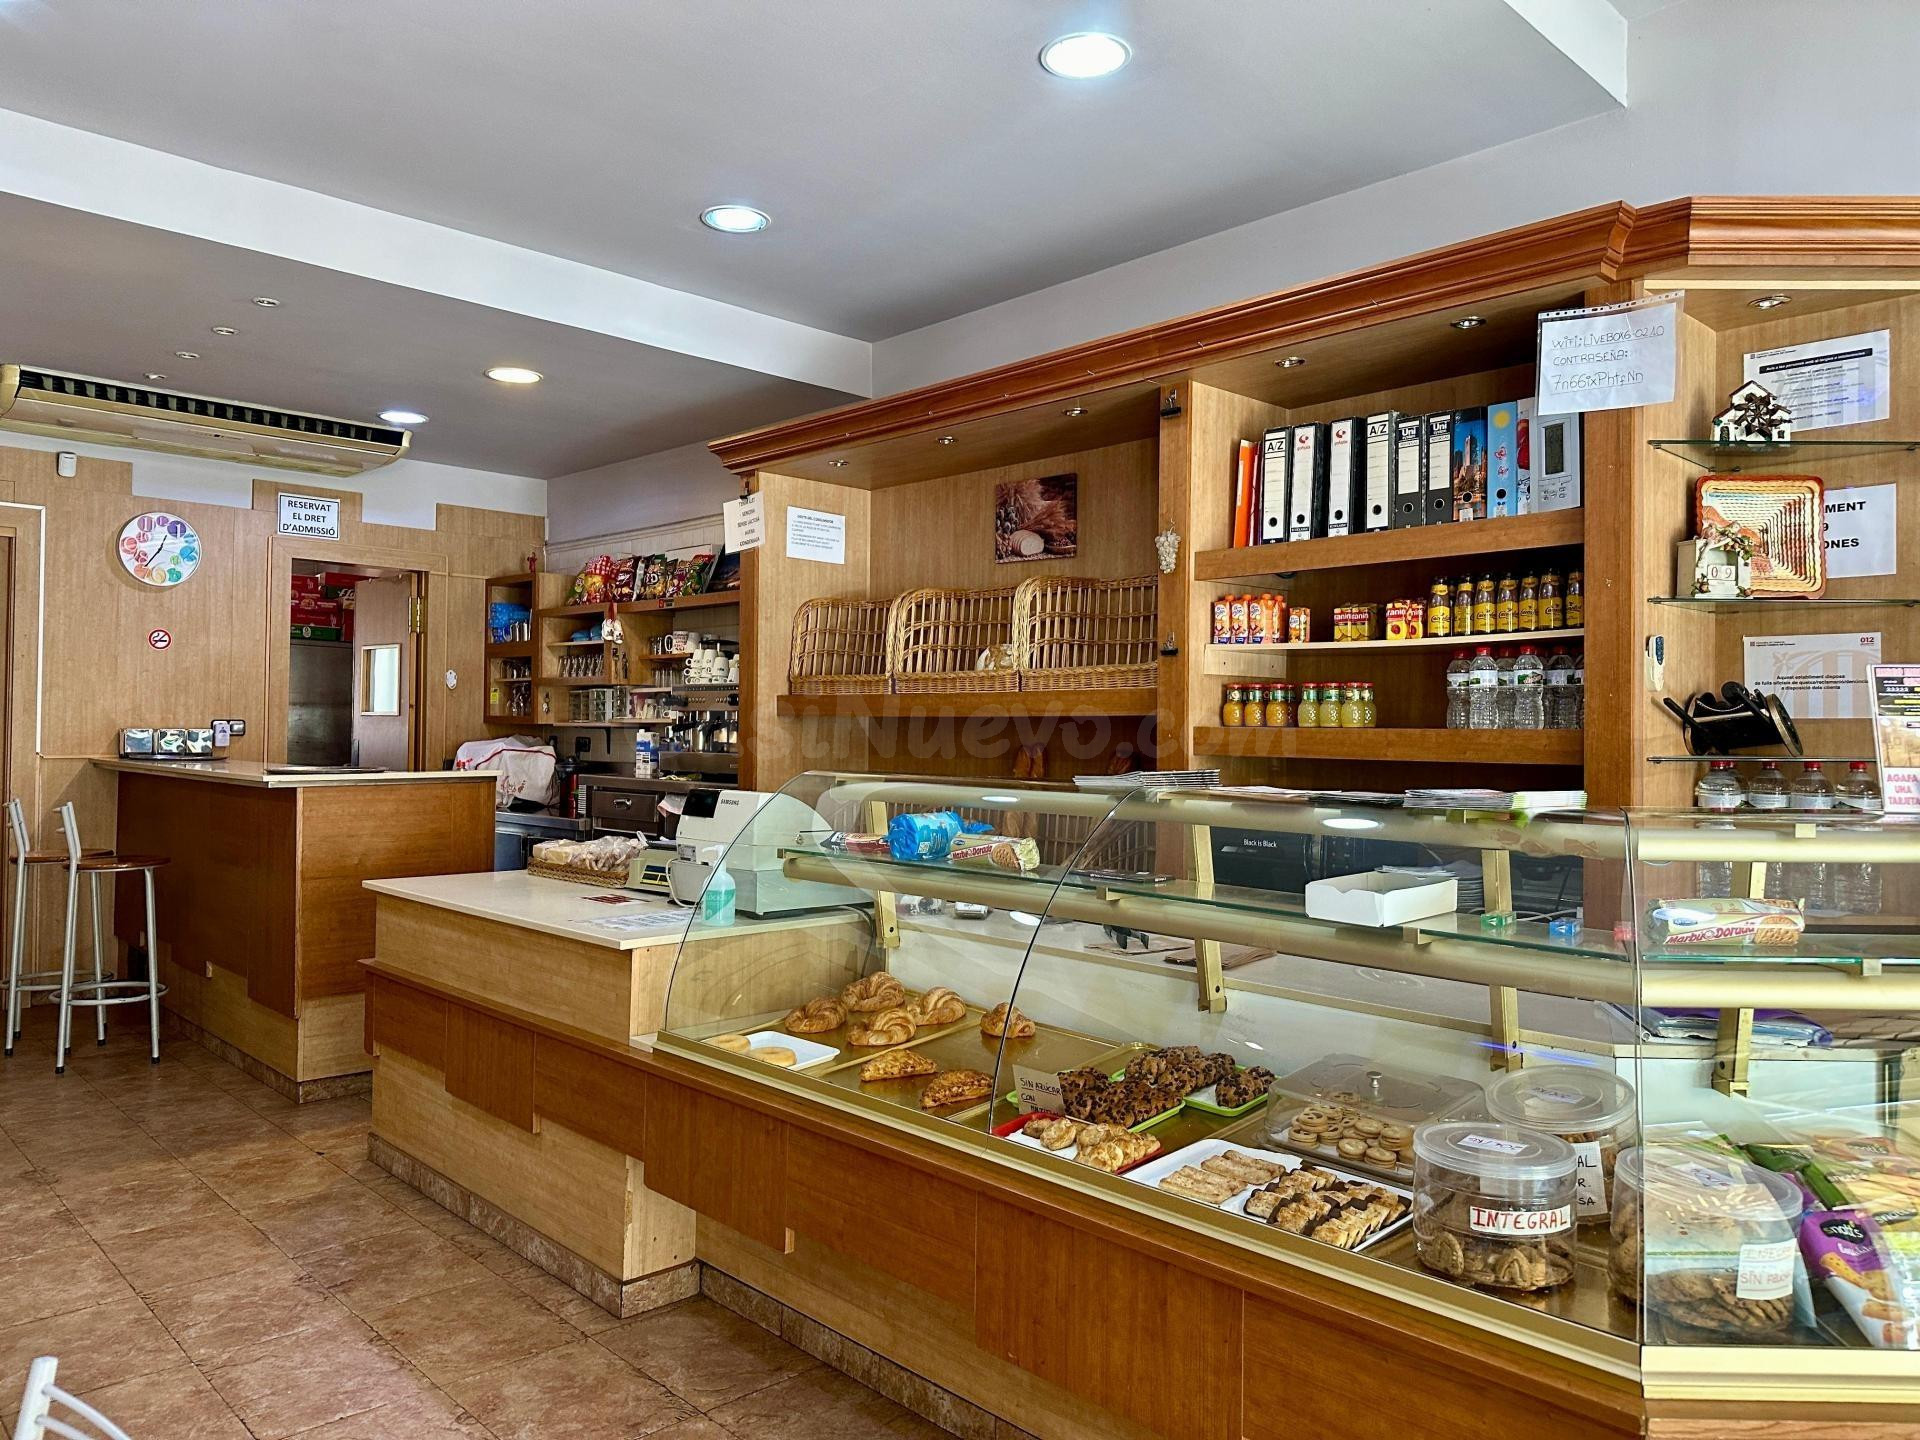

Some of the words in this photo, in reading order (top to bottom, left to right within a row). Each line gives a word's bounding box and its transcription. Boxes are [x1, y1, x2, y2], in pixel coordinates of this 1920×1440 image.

[1369, 424, 1387, 436] A/Z
[1267, 441, 1284, 452] A/Z
[288, 500, 331, 511] RESERVAT
[1825, 501, 1866, 513] MENT
[292, 512, 302, 520] EL
[304, 513, 326, 523] DRET
[1243, 838, 1257, 847] Black
[1262, 839, 1278, 849] Black
[1020, 1078, 1034, 1088] SIN
[1021, 1092, 1036, 1102] CON
[1472, 1206, 1568, 1230] INTEGRAL
